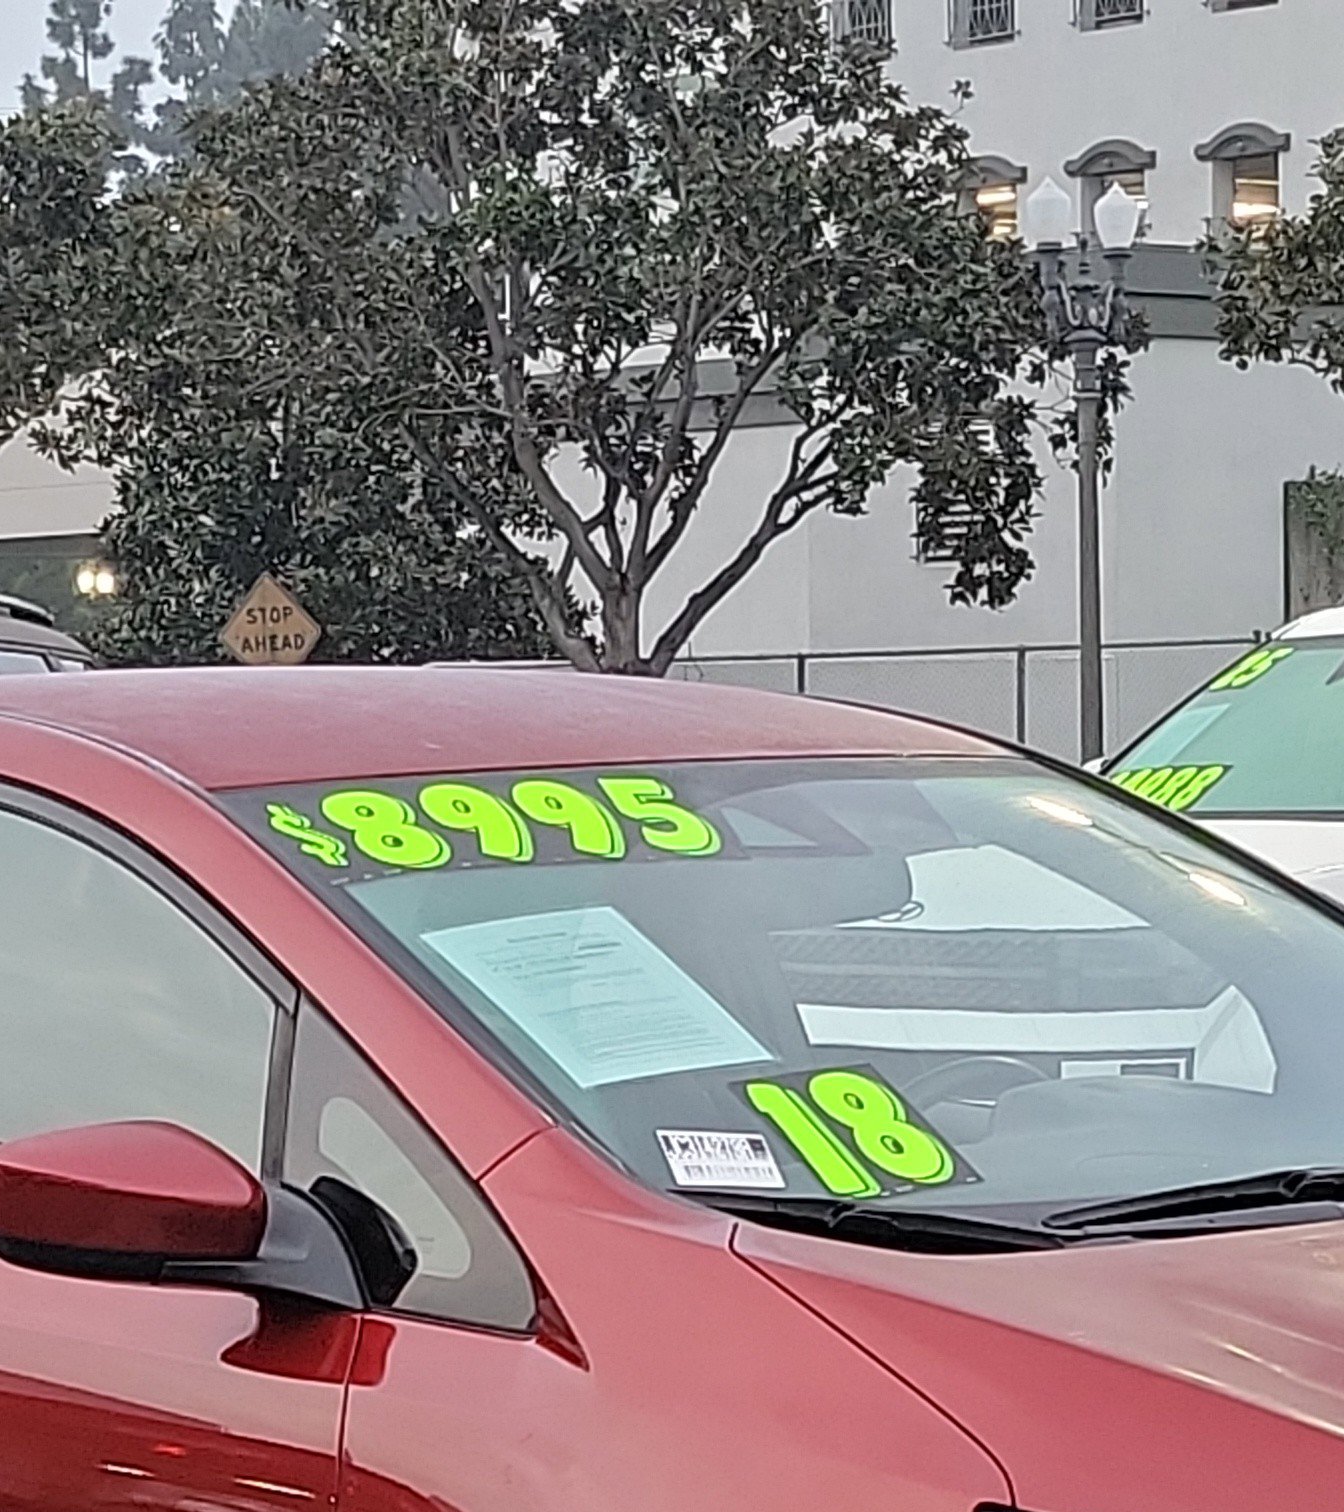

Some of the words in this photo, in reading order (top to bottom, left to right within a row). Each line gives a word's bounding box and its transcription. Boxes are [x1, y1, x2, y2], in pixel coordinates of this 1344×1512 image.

[241, 634, 305, 653] AHEAD
[246, 606, 294, 625] STOP
[266, 775, 722, 870] $8995
[745, 1069, 955, 1199] 18
